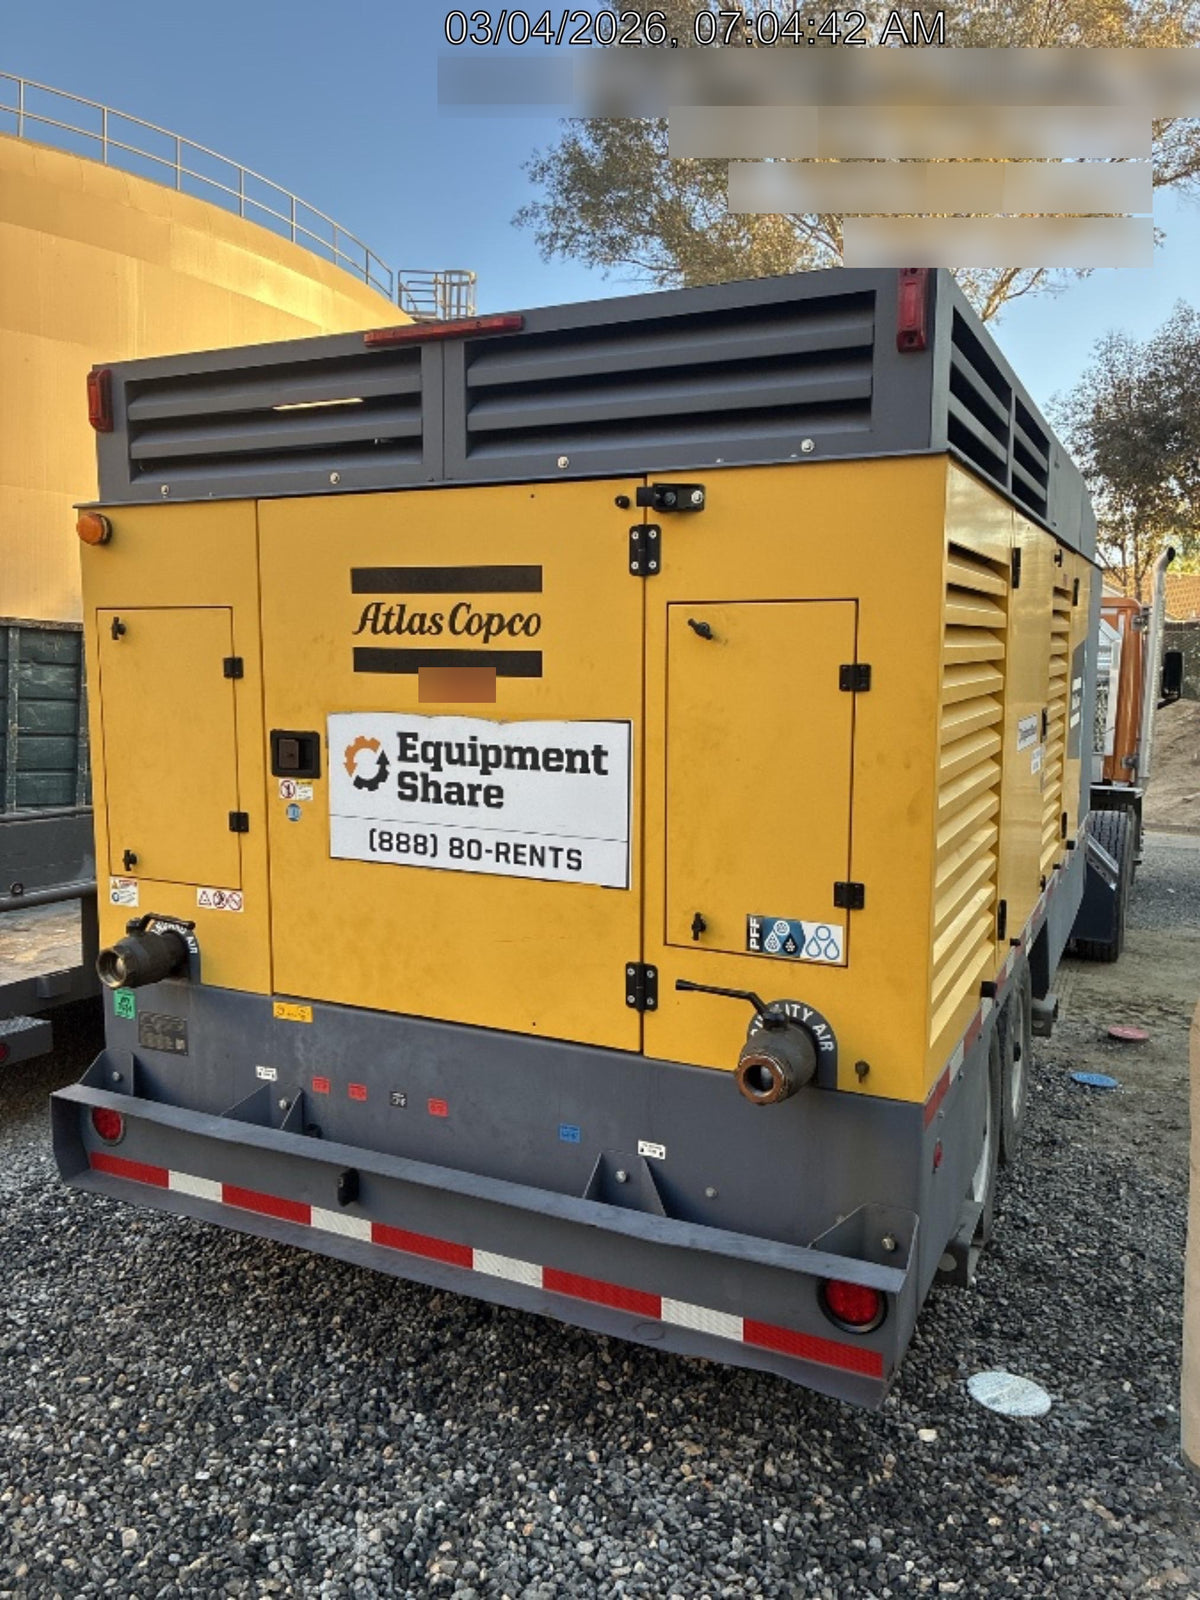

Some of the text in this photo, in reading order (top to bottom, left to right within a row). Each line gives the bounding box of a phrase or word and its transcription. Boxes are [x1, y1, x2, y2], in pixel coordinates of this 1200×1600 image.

[352, 602, 542, 644] Atlas Copco
[396, 731, 609, 776] Equipment
[397, 770, 504, 809] Share
[368, 827, 583, 872] (888) 80-RENTS
[750, 918, 760, 950] PFF
[812, 1023, 836, 1052] AIR
